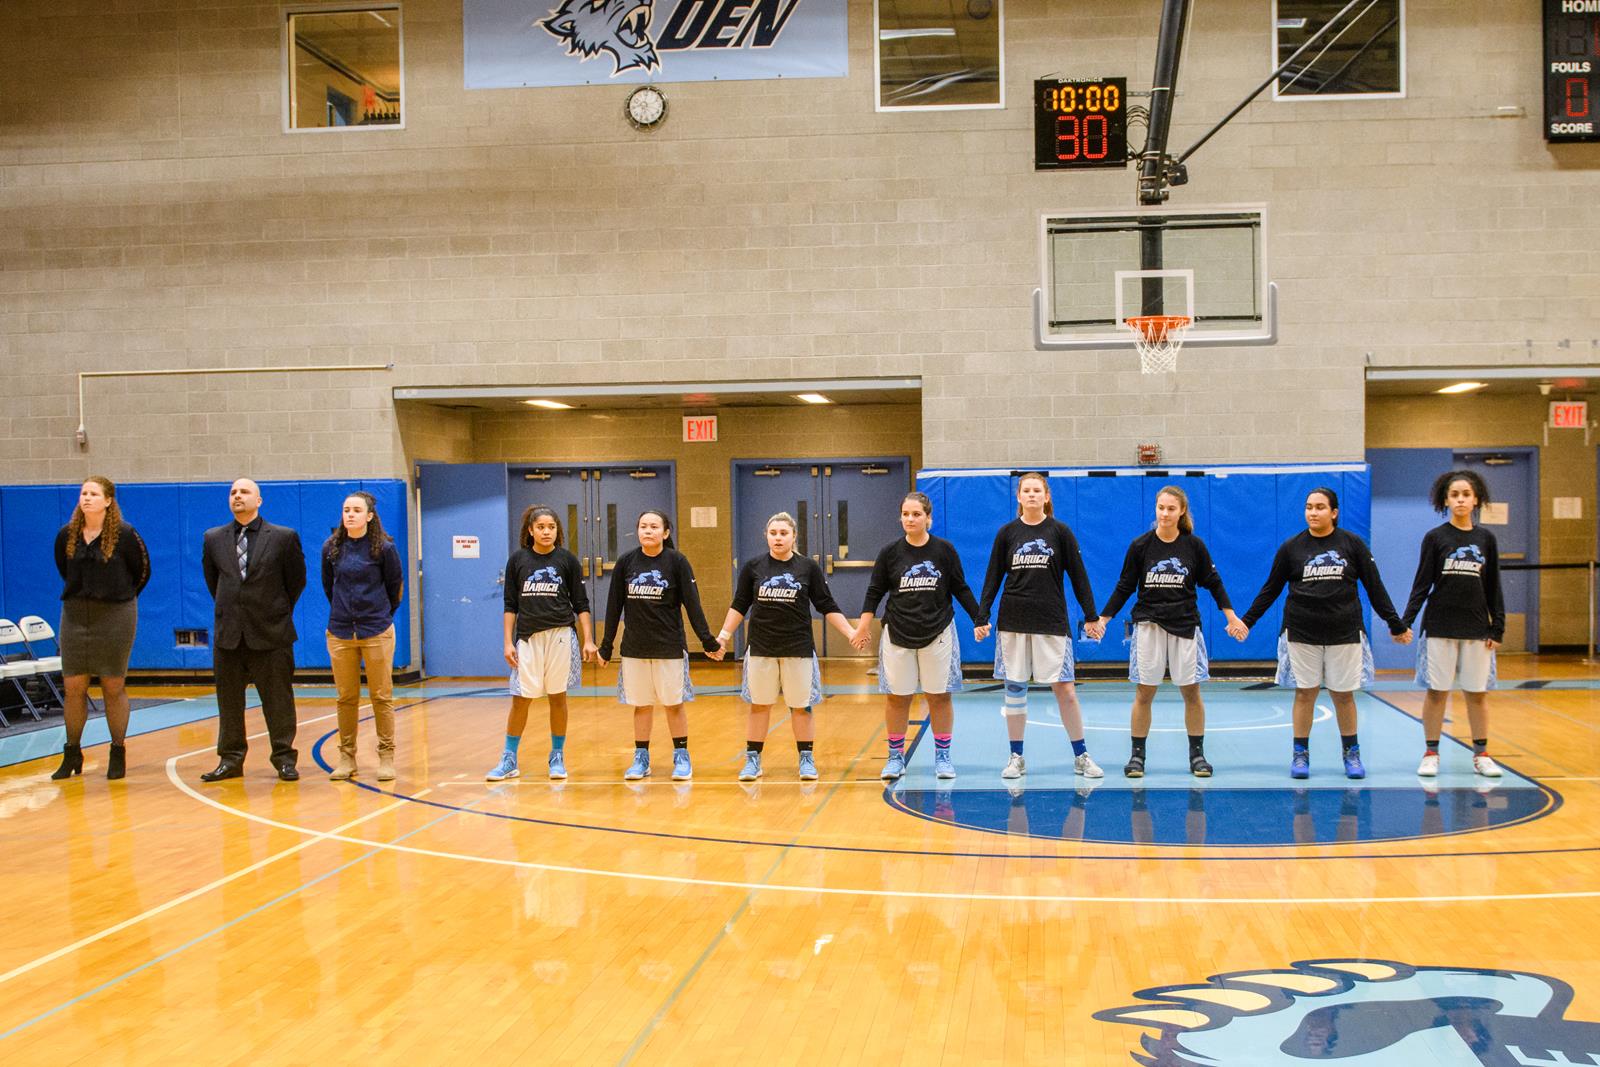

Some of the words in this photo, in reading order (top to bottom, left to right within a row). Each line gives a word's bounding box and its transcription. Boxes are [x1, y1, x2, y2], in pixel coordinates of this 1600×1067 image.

[655, 0, 798, 51] DEN
[1551, 62, 1591, 72] FOULS
[1052, 85, 1119, 112] 10:00
[1551, 123, 1593, 134] SCORE
[1056, 115, 1108, 159] 30
[1554, 405, 1584, 427] EXIT
[687, 419, 714, 440] EXIT
[1013, 554, 1050, 565] BARUCH
[1145, 572, 1185, 583] BARUCH
[1303, 565, 1344, 578] BARUCH
[522, 580, 560, 593] BARUCH
[900, 576, 938, 588] BARUCH
[628, 583, 664, 595] BARUCH
[758, 586, 798, 598] BARUCH
